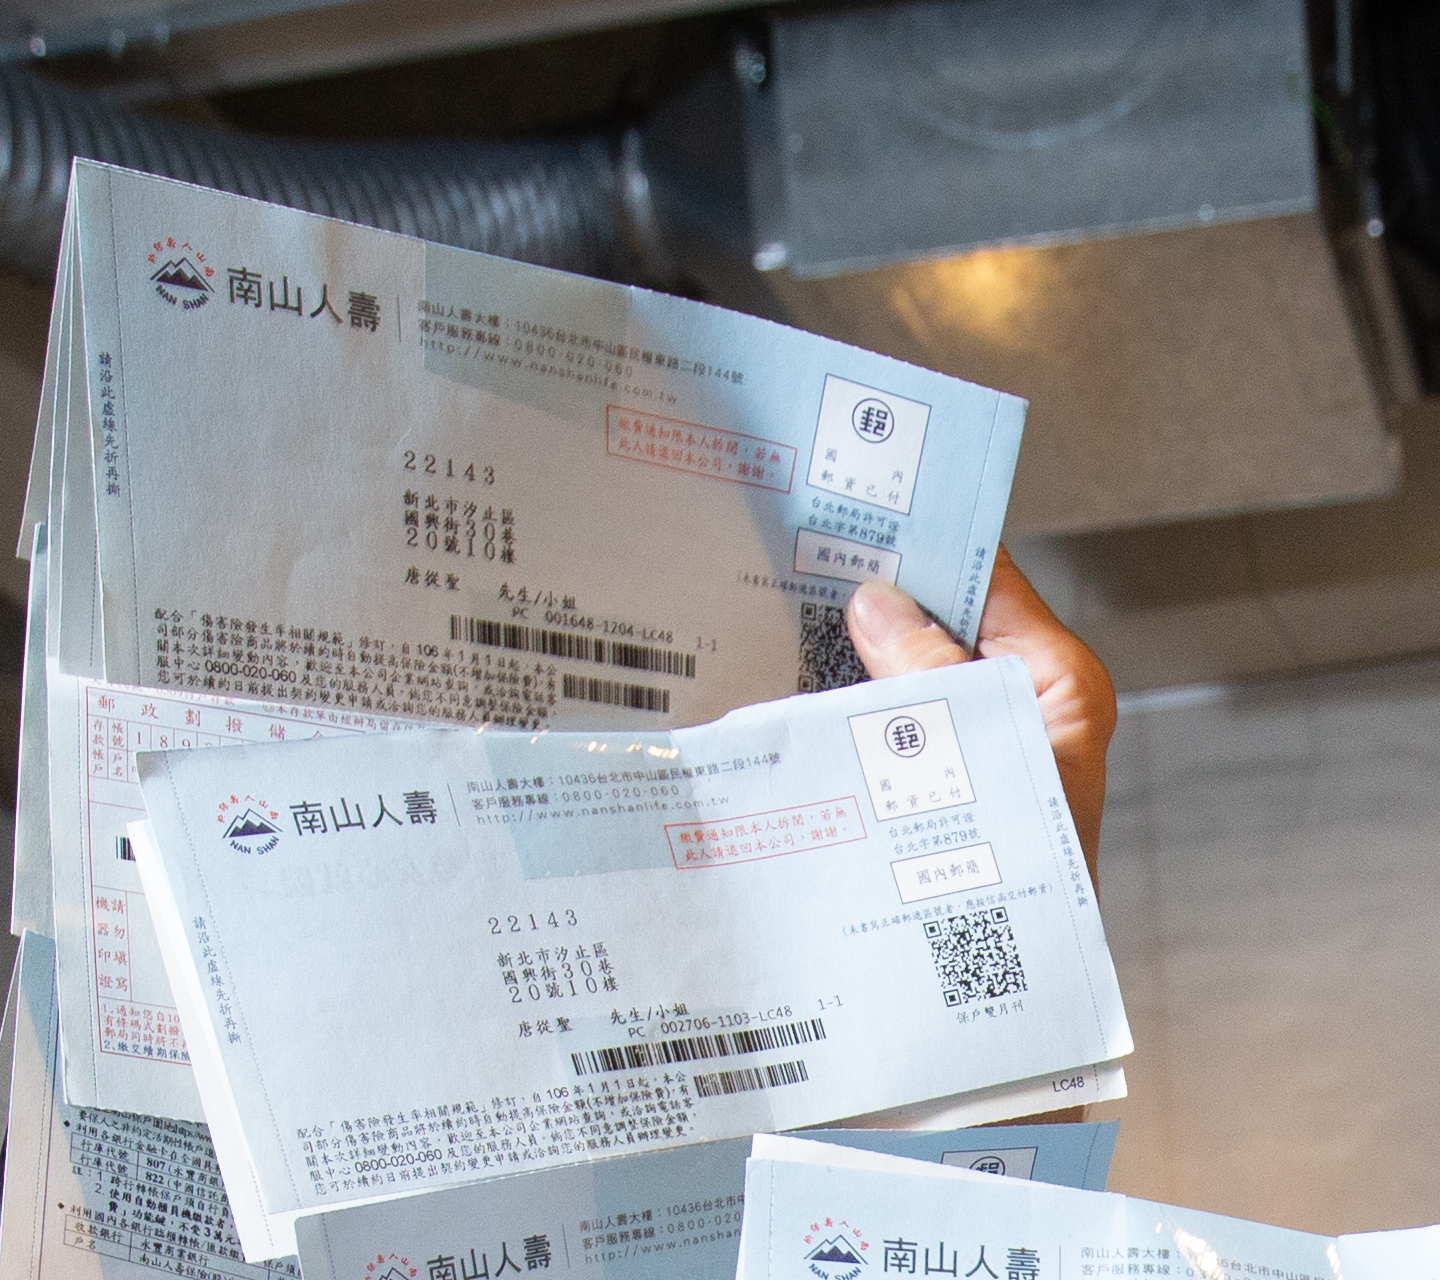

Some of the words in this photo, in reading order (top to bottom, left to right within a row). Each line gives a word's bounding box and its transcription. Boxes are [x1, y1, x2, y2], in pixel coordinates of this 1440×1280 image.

[155, 284, 177, 305] NAN
[182, 293, 209, 310] SHAN
[227, 267, 382, 332] 南山人壽
[404, 450, 495, 485] 22143
[820, 468, 900, 506] 郵資已付
[807, 514, 899, 548] 台北字第879號
[816, 546, 880, 574] 國內郵簡
[404, 566, 460, 591] 唐從聖
[499, 582, 577, 610] 先生/小姐
[512, 607, 528, 620] PC
[545, 609, 674, 643] 001648-1204-LC48
[204, 659, 297, 684] 0800-020-060
[289, 789, 438, 837] 南山人壽
[884, 786, 962, 812] 郵資已付
[888, 811, 975, 839] 台北郵局許可證
[894, 827, 981, 855] 台北字第879號
[916, 860, 980, 885] 國內郵簡
[488, 909, 578, 936] 22143
[496, 940, 610, 970] 新北市汐止區
[193, 915, 242, 1046] 請沿此虛線先折再撕
[502, 958, 615, 986] 國興街30巷
[510, 975, 620, 1004] 20號10樓
[517, 1016, 573, 1038] 唐從聖
[610, 1001, 689, 1027] 先生/小姐
[628, 1027, 645, 1039] PC
[661, 1005, 793, 1034] 002706-1103-LC48
[818, 995, 844, 1011] 1-1
[956, 1000, 1025, 1024] 保戶雙月刊
[1052, 1076, 1085, 1092] LC48
[354, 1149, 442, 1174] 0800-020-060
